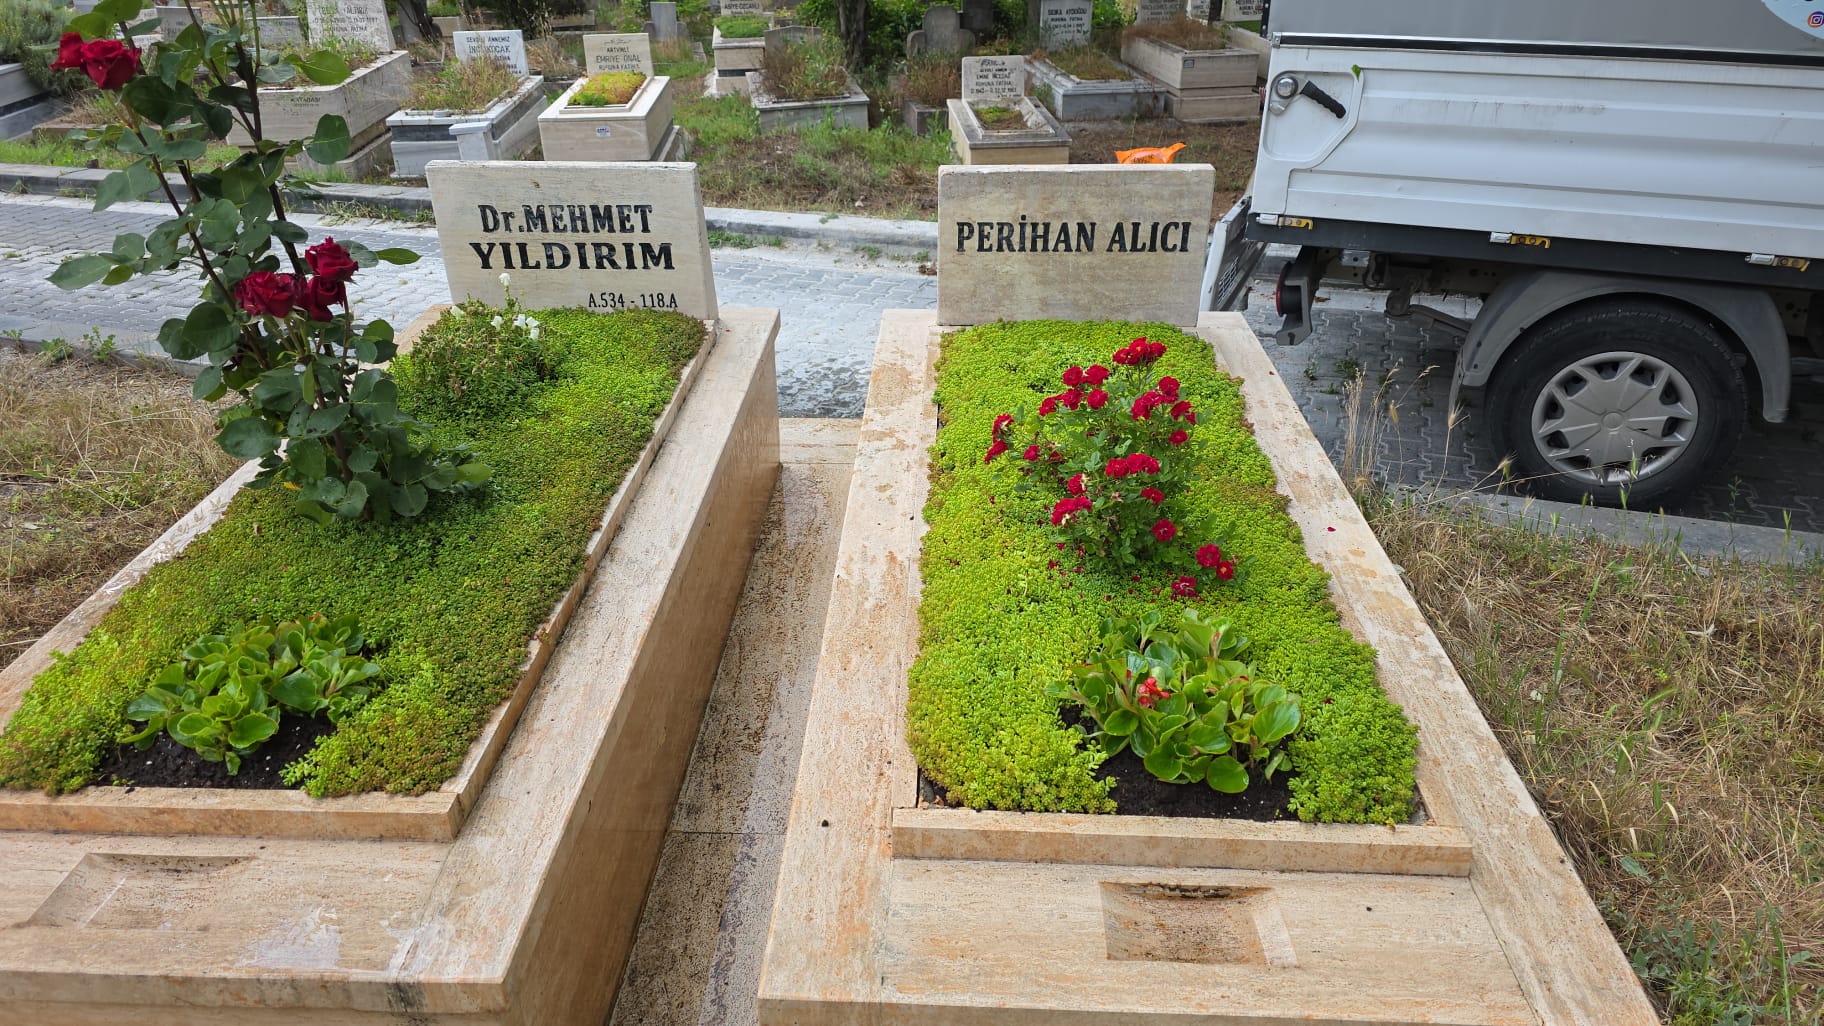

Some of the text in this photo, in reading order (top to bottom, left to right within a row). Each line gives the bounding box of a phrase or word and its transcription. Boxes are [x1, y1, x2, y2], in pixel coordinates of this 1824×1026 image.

[956, 214, 1193, 253] PERİHAN ALICI
[469, 242, 676, 270] YILDIRIM
[588, 292, 626, 309] A.534
[639, 292, 679, 309] 118.A
